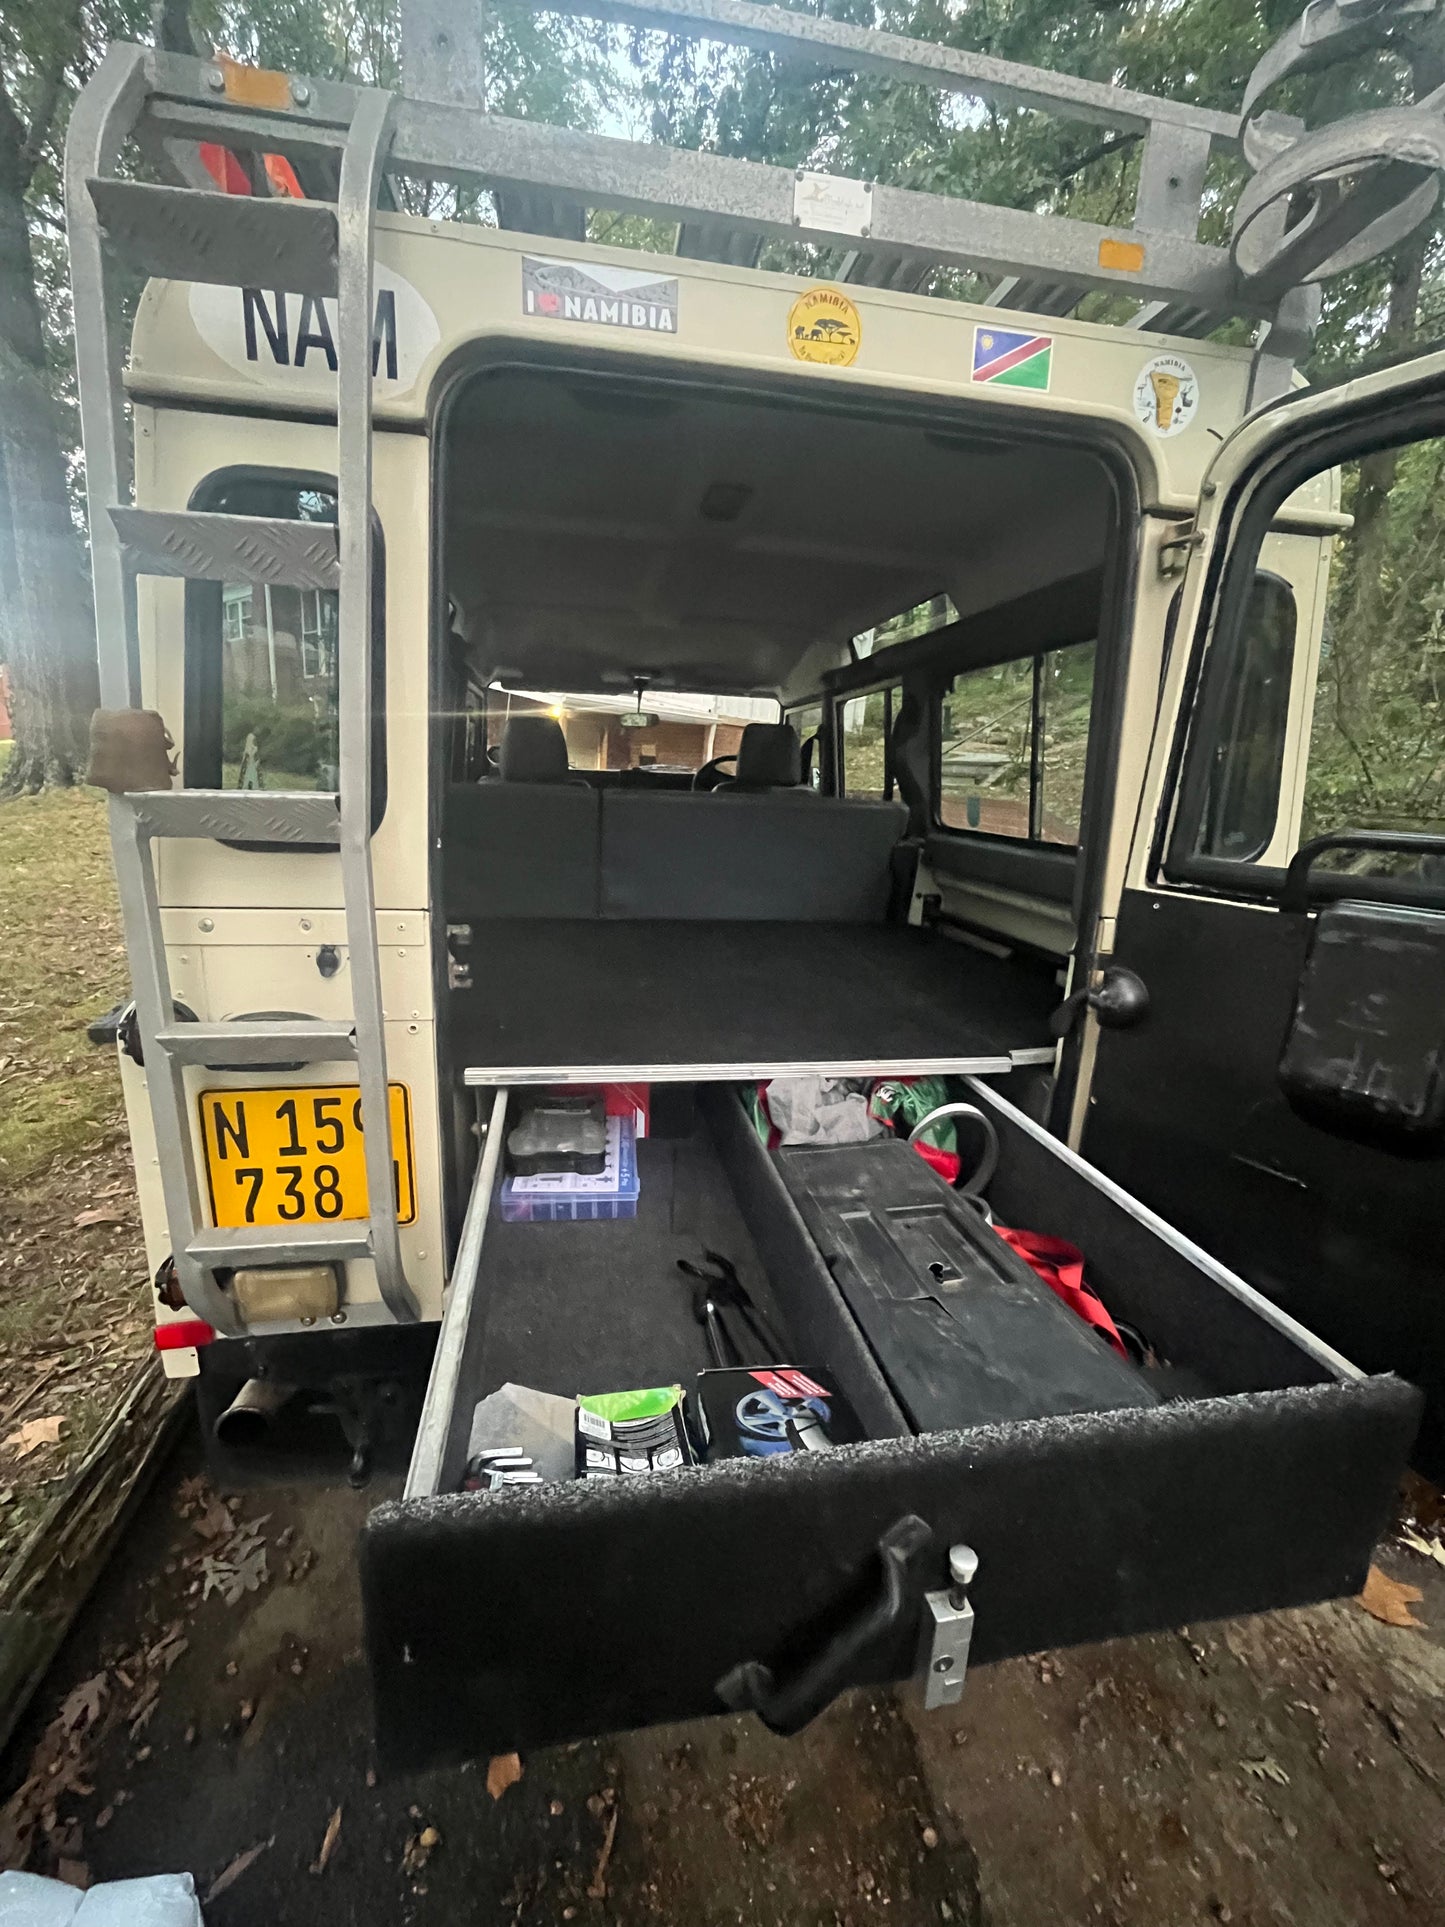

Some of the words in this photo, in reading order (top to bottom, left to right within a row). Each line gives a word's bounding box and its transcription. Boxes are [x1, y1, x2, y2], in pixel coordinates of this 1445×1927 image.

[528, 290, 535, 312] I
[565, 295, 672, 330] NAMIBIA
[804, 293, 849, 314] NAMIBIA
[1154, 360, 1186, 371] NAMIBIA
[213, 1101, 250, 1159] N
[235, 1165, 344, 1222] 738
